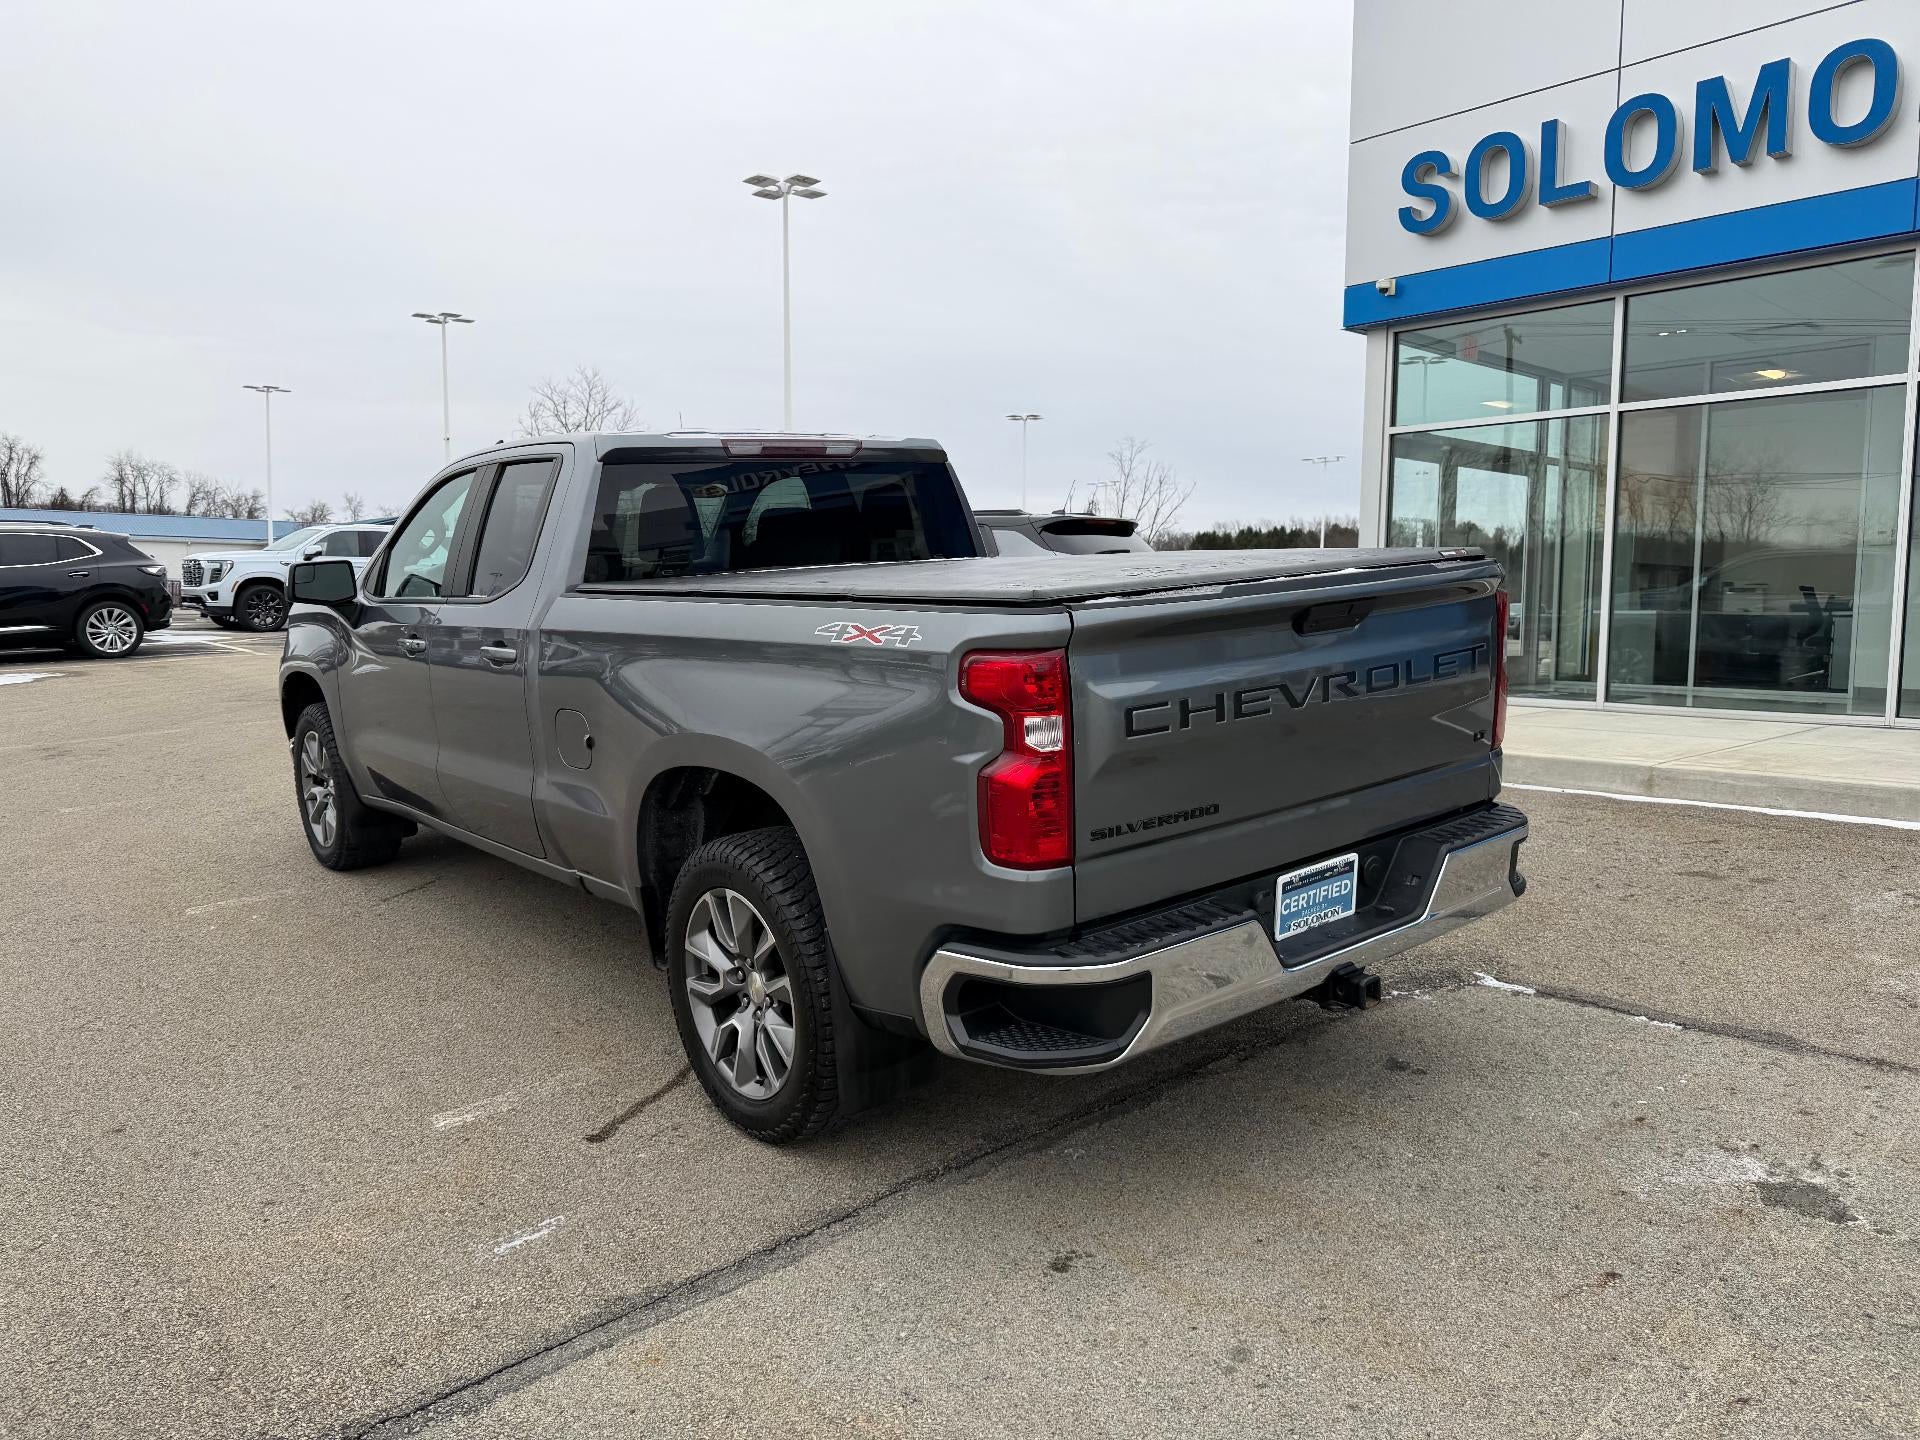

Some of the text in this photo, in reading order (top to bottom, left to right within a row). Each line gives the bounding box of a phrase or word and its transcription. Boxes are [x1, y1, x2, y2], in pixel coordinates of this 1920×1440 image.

[1397, 37, 1920, 236] SOLOMO
[1124, 642, 1487, 739] CHEVROLET
[1473, 729, 1488, 742] LT
[1090, 803, 1220, 841] SILVERADO
[1281, 879, 1351, 915] CERTIFIED
[1292, 906, 1341, 931] SOLOMON
